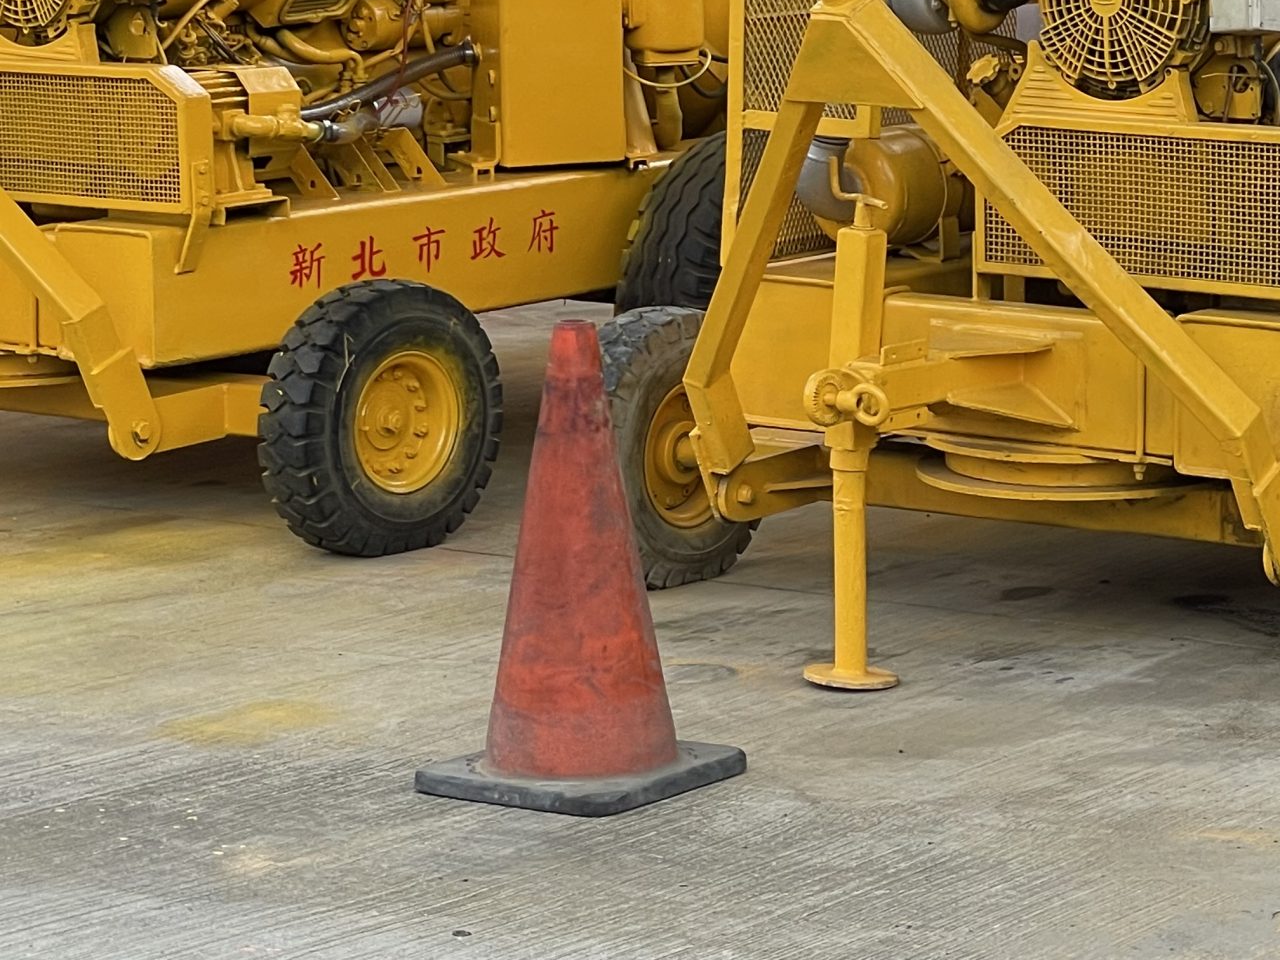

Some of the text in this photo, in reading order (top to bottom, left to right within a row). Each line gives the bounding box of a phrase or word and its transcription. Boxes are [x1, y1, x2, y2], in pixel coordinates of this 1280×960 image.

[288, 208, 560, 289] 新北市政府
